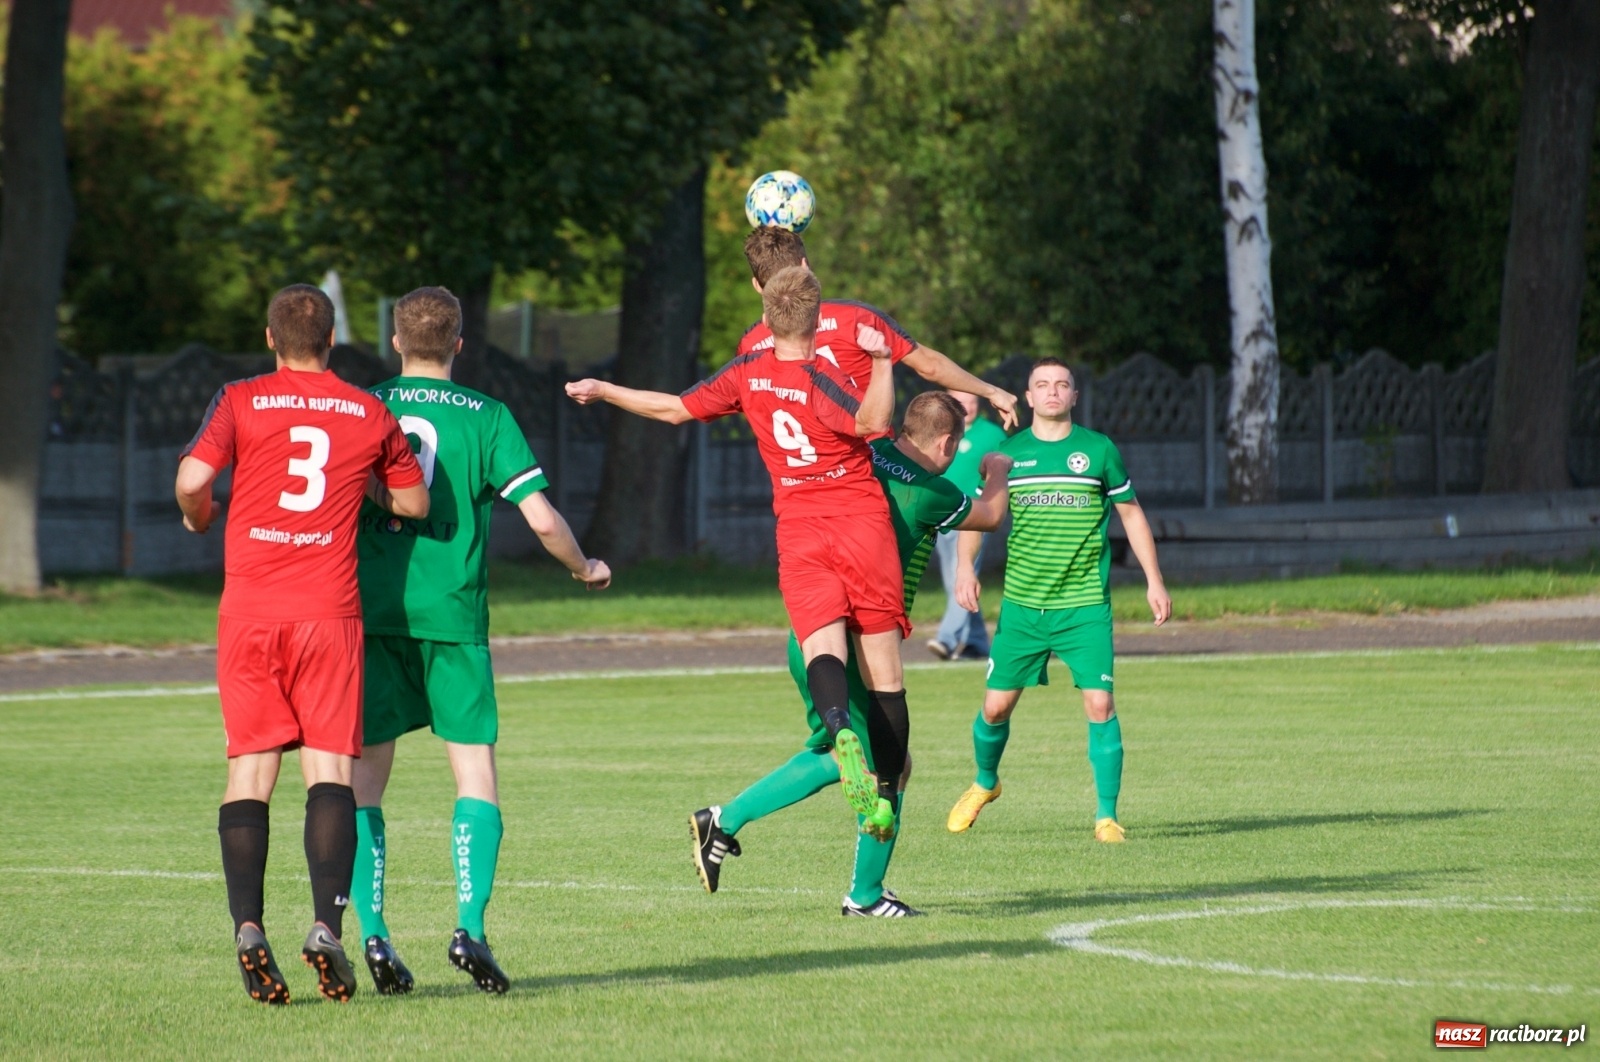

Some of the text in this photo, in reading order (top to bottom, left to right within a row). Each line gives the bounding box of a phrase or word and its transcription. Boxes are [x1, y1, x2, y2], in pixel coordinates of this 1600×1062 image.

[252, 395, 366, 418] GRANICA RUPTAWA
[772, 409, 818, 467] 9
[277, 425, 330, 513] 3
